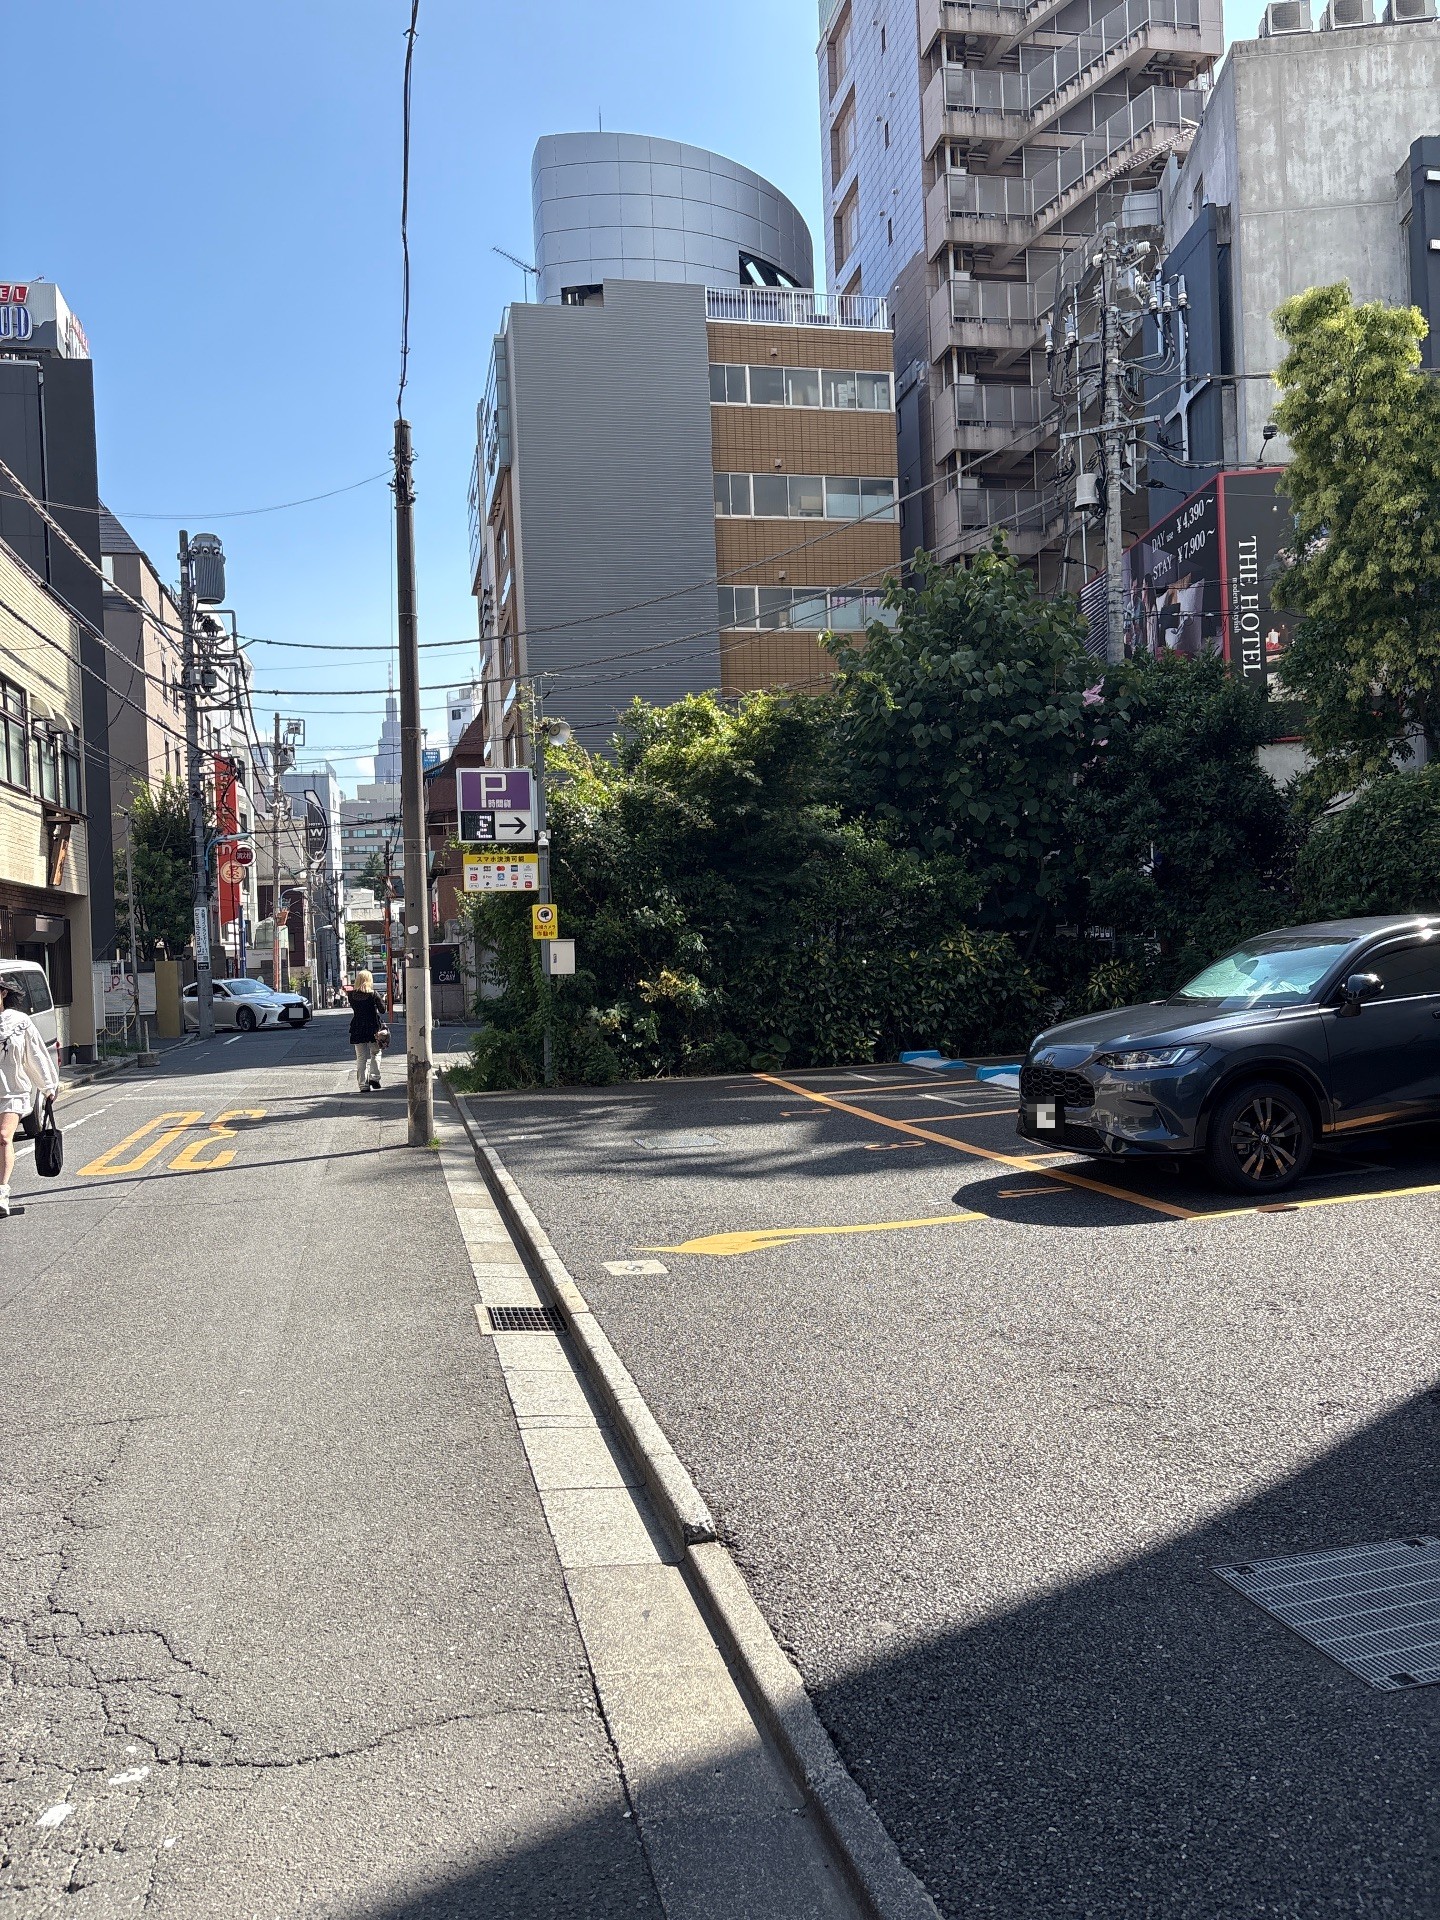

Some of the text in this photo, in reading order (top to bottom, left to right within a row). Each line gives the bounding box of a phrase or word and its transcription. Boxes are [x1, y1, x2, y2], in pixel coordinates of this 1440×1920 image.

[1152, 531, 1165, 553] DAY
[1152, 554, 1173, 580] STAY
[1239, 536, 1261, 678] THE HOTEL
[481, 774, 506, 808] P
[310, 828, 324, 836] W
